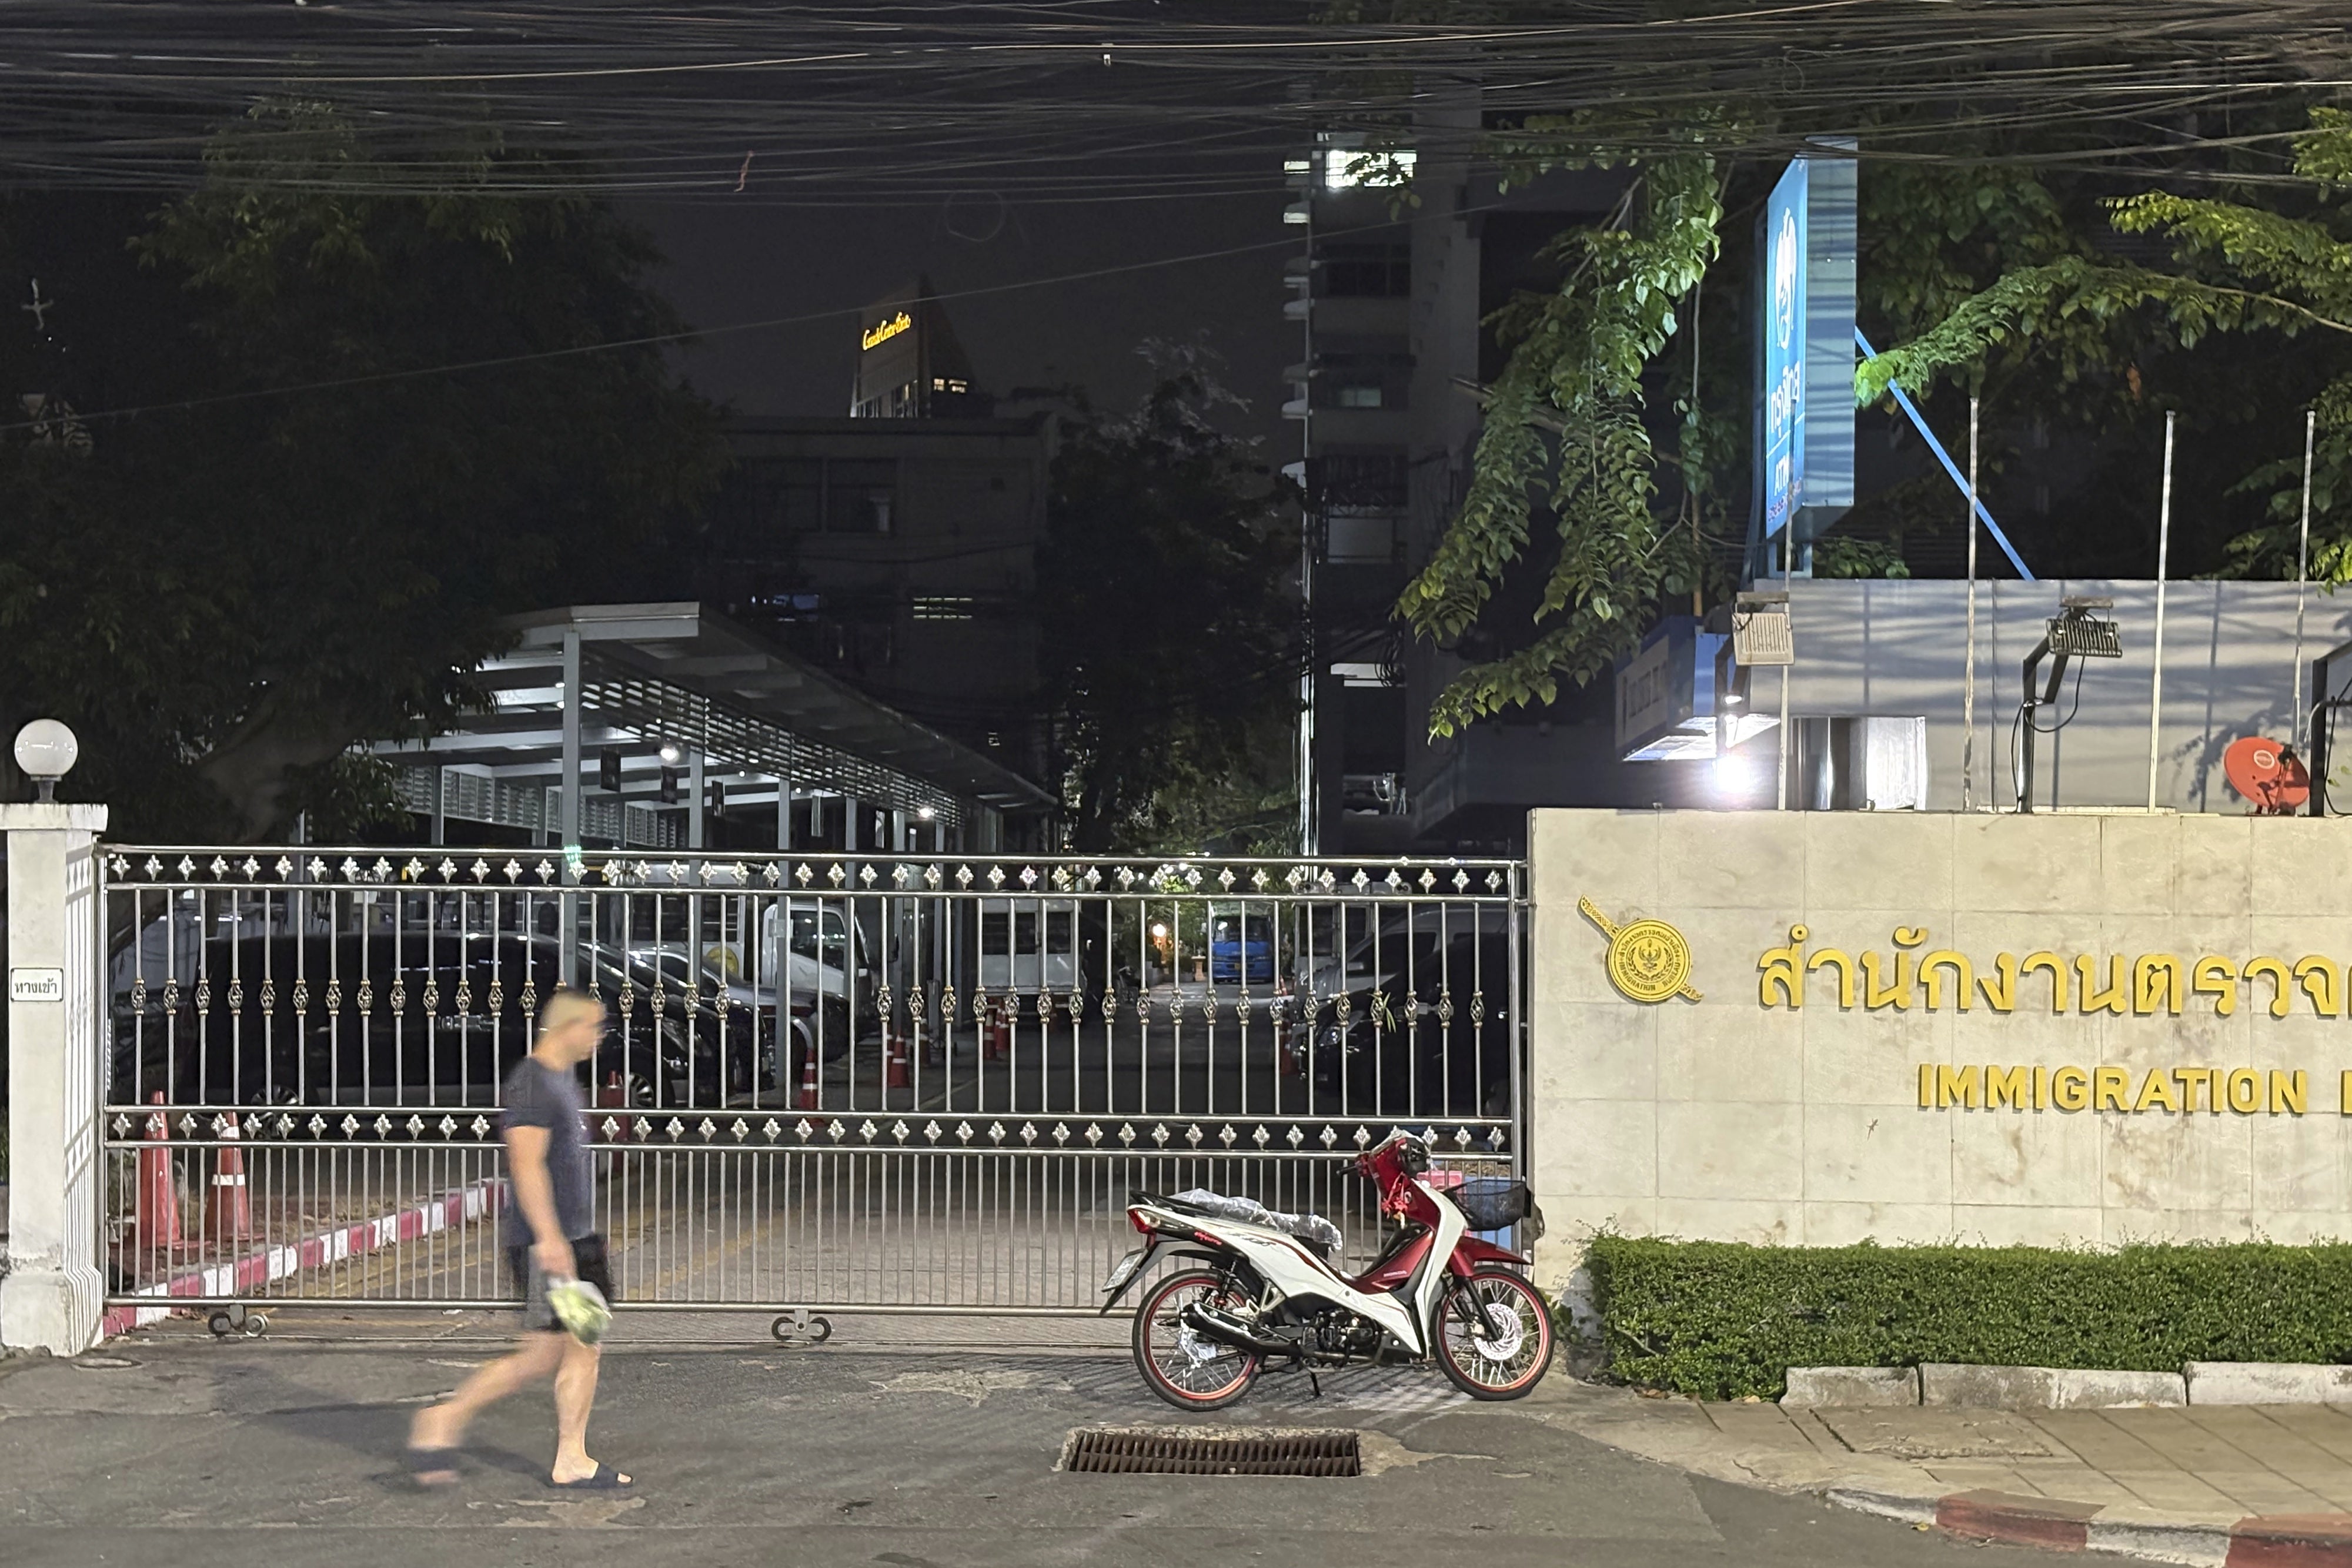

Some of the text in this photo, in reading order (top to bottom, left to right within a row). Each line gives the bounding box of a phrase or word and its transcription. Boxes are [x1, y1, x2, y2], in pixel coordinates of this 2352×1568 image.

[15, 978, 57, 994] ทางเข้า
[1618, 961, 1656, 991] IMMIGRATION
[1759, 924, 2352, 1016] สำนักงานตรวจ
[1920, 1064, 2308, 1114] IMMIGRATION
